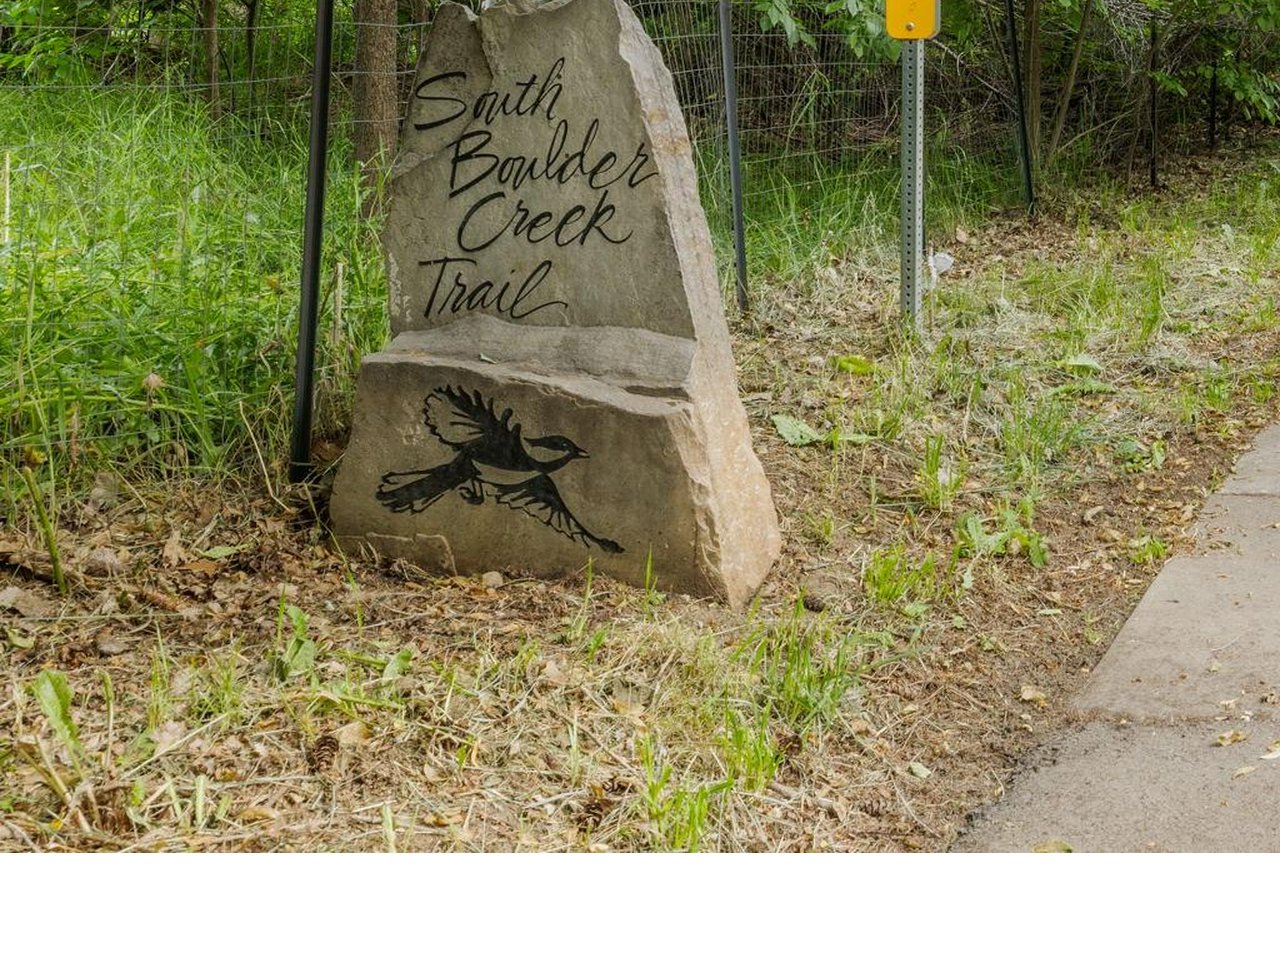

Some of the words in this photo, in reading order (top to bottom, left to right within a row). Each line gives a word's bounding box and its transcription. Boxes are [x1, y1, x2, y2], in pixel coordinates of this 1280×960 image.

[413, 57, 565, 131] South
[448, 118, 660, 198] Boulder
[457, 190, 633, 252] Creek
[418, 256, 569, 319] Trail
